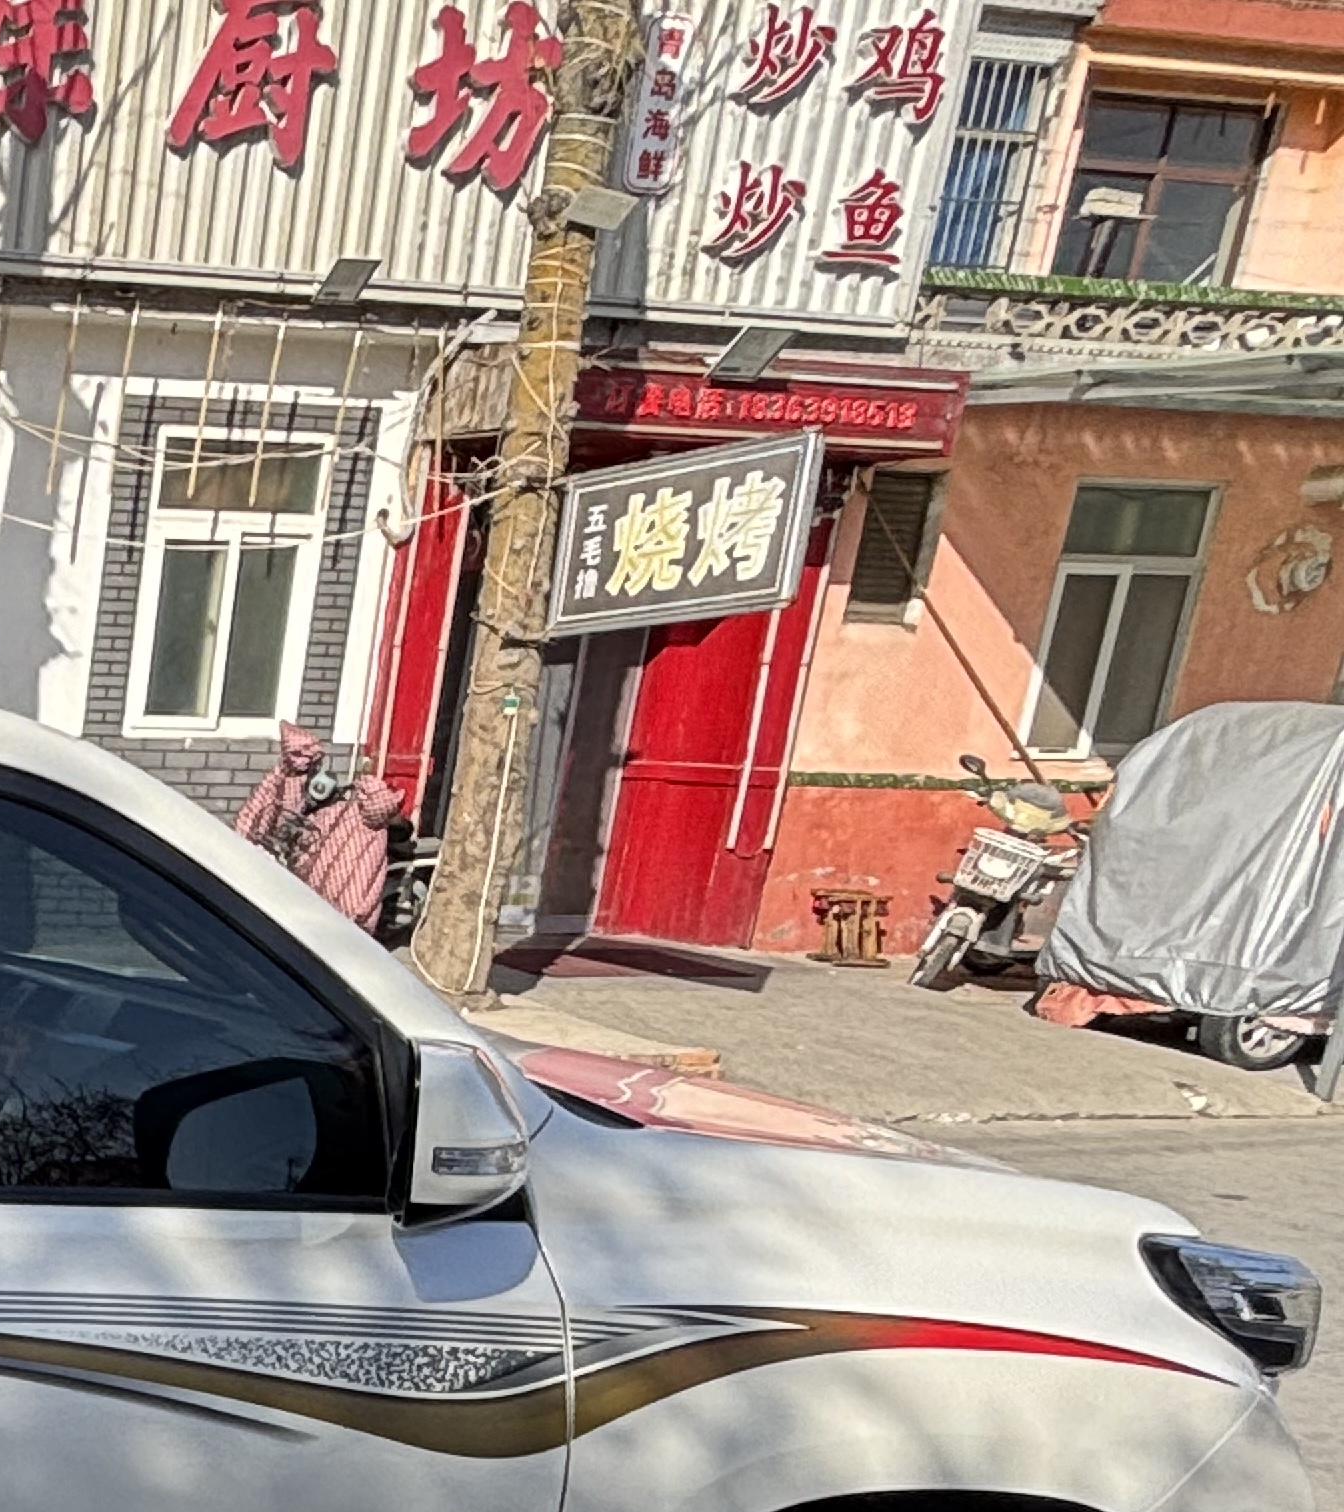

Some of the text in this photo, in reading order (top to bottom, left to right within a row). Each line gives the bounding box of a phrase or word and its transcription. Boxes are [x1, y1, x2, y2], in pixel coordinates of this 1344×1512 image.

[636, 27, 684, 183] 青岛海鲜
[738, 3, 947, 122] 炒鸡
[712, 160, 903, 265] 炒鱼
[604, 470, 786, 597] 烧烤
